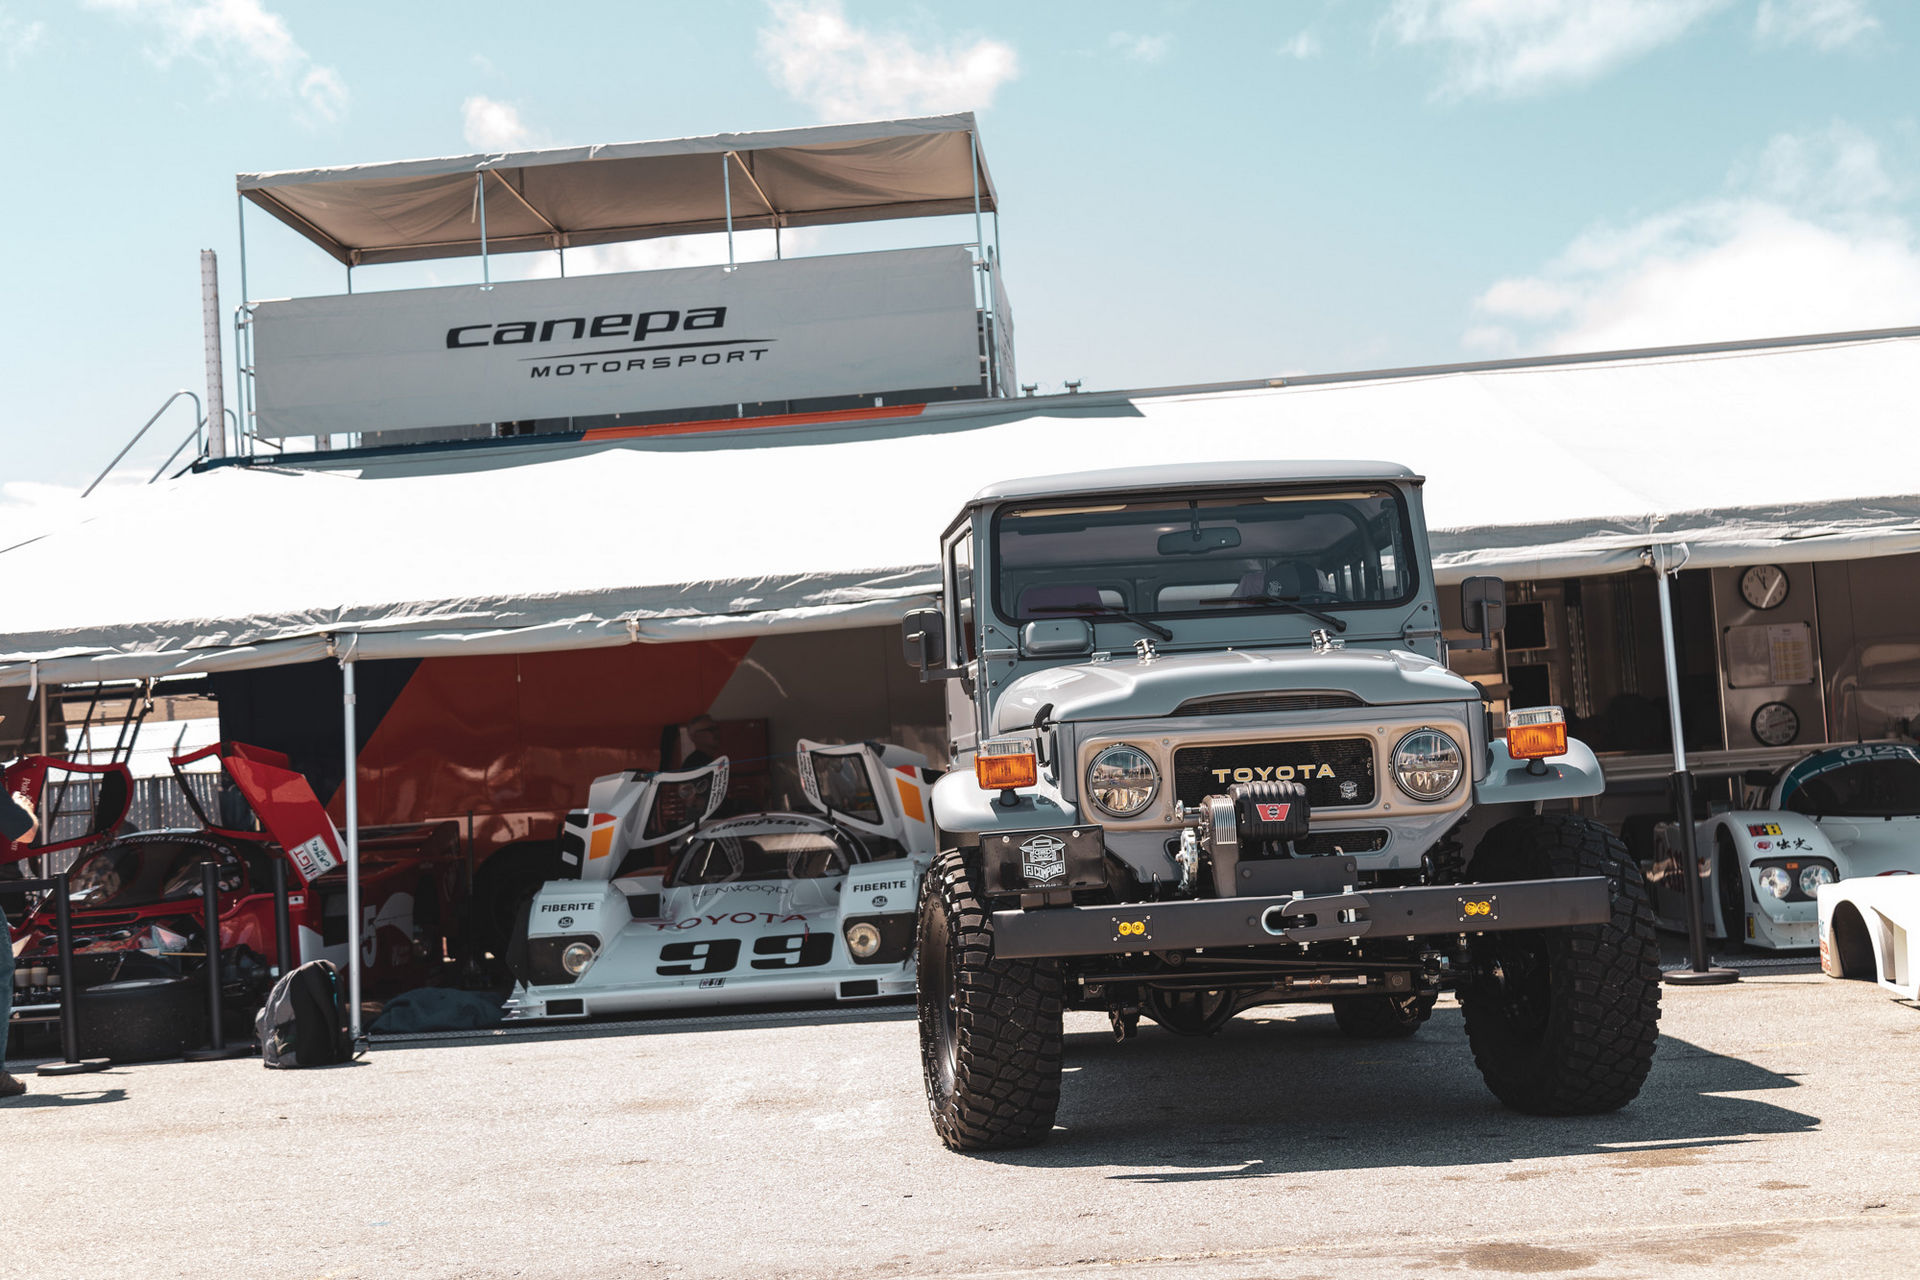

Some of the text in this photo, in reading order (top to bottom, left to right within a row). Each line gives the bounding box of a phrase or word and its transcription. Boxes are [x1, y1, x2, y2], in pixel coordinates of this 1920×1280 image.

[446, 306, 727, 349] canepa
[530, 349, 769, 378] MOTORSPORT
[1211, 763, 1336, 784] TOYOTA
[292, 850, 312, 867] GT
[1025, 863, 1064, 880] FJ COMPANY
[692, 884, 789, 900] KENWOOD
[853, 880, 907, 893] FIBERITE
[541, 902, 596, 913] FIBERITE
[650, 912, 808, 931] TOYOTA
[656, 932, 835, 976] 99
